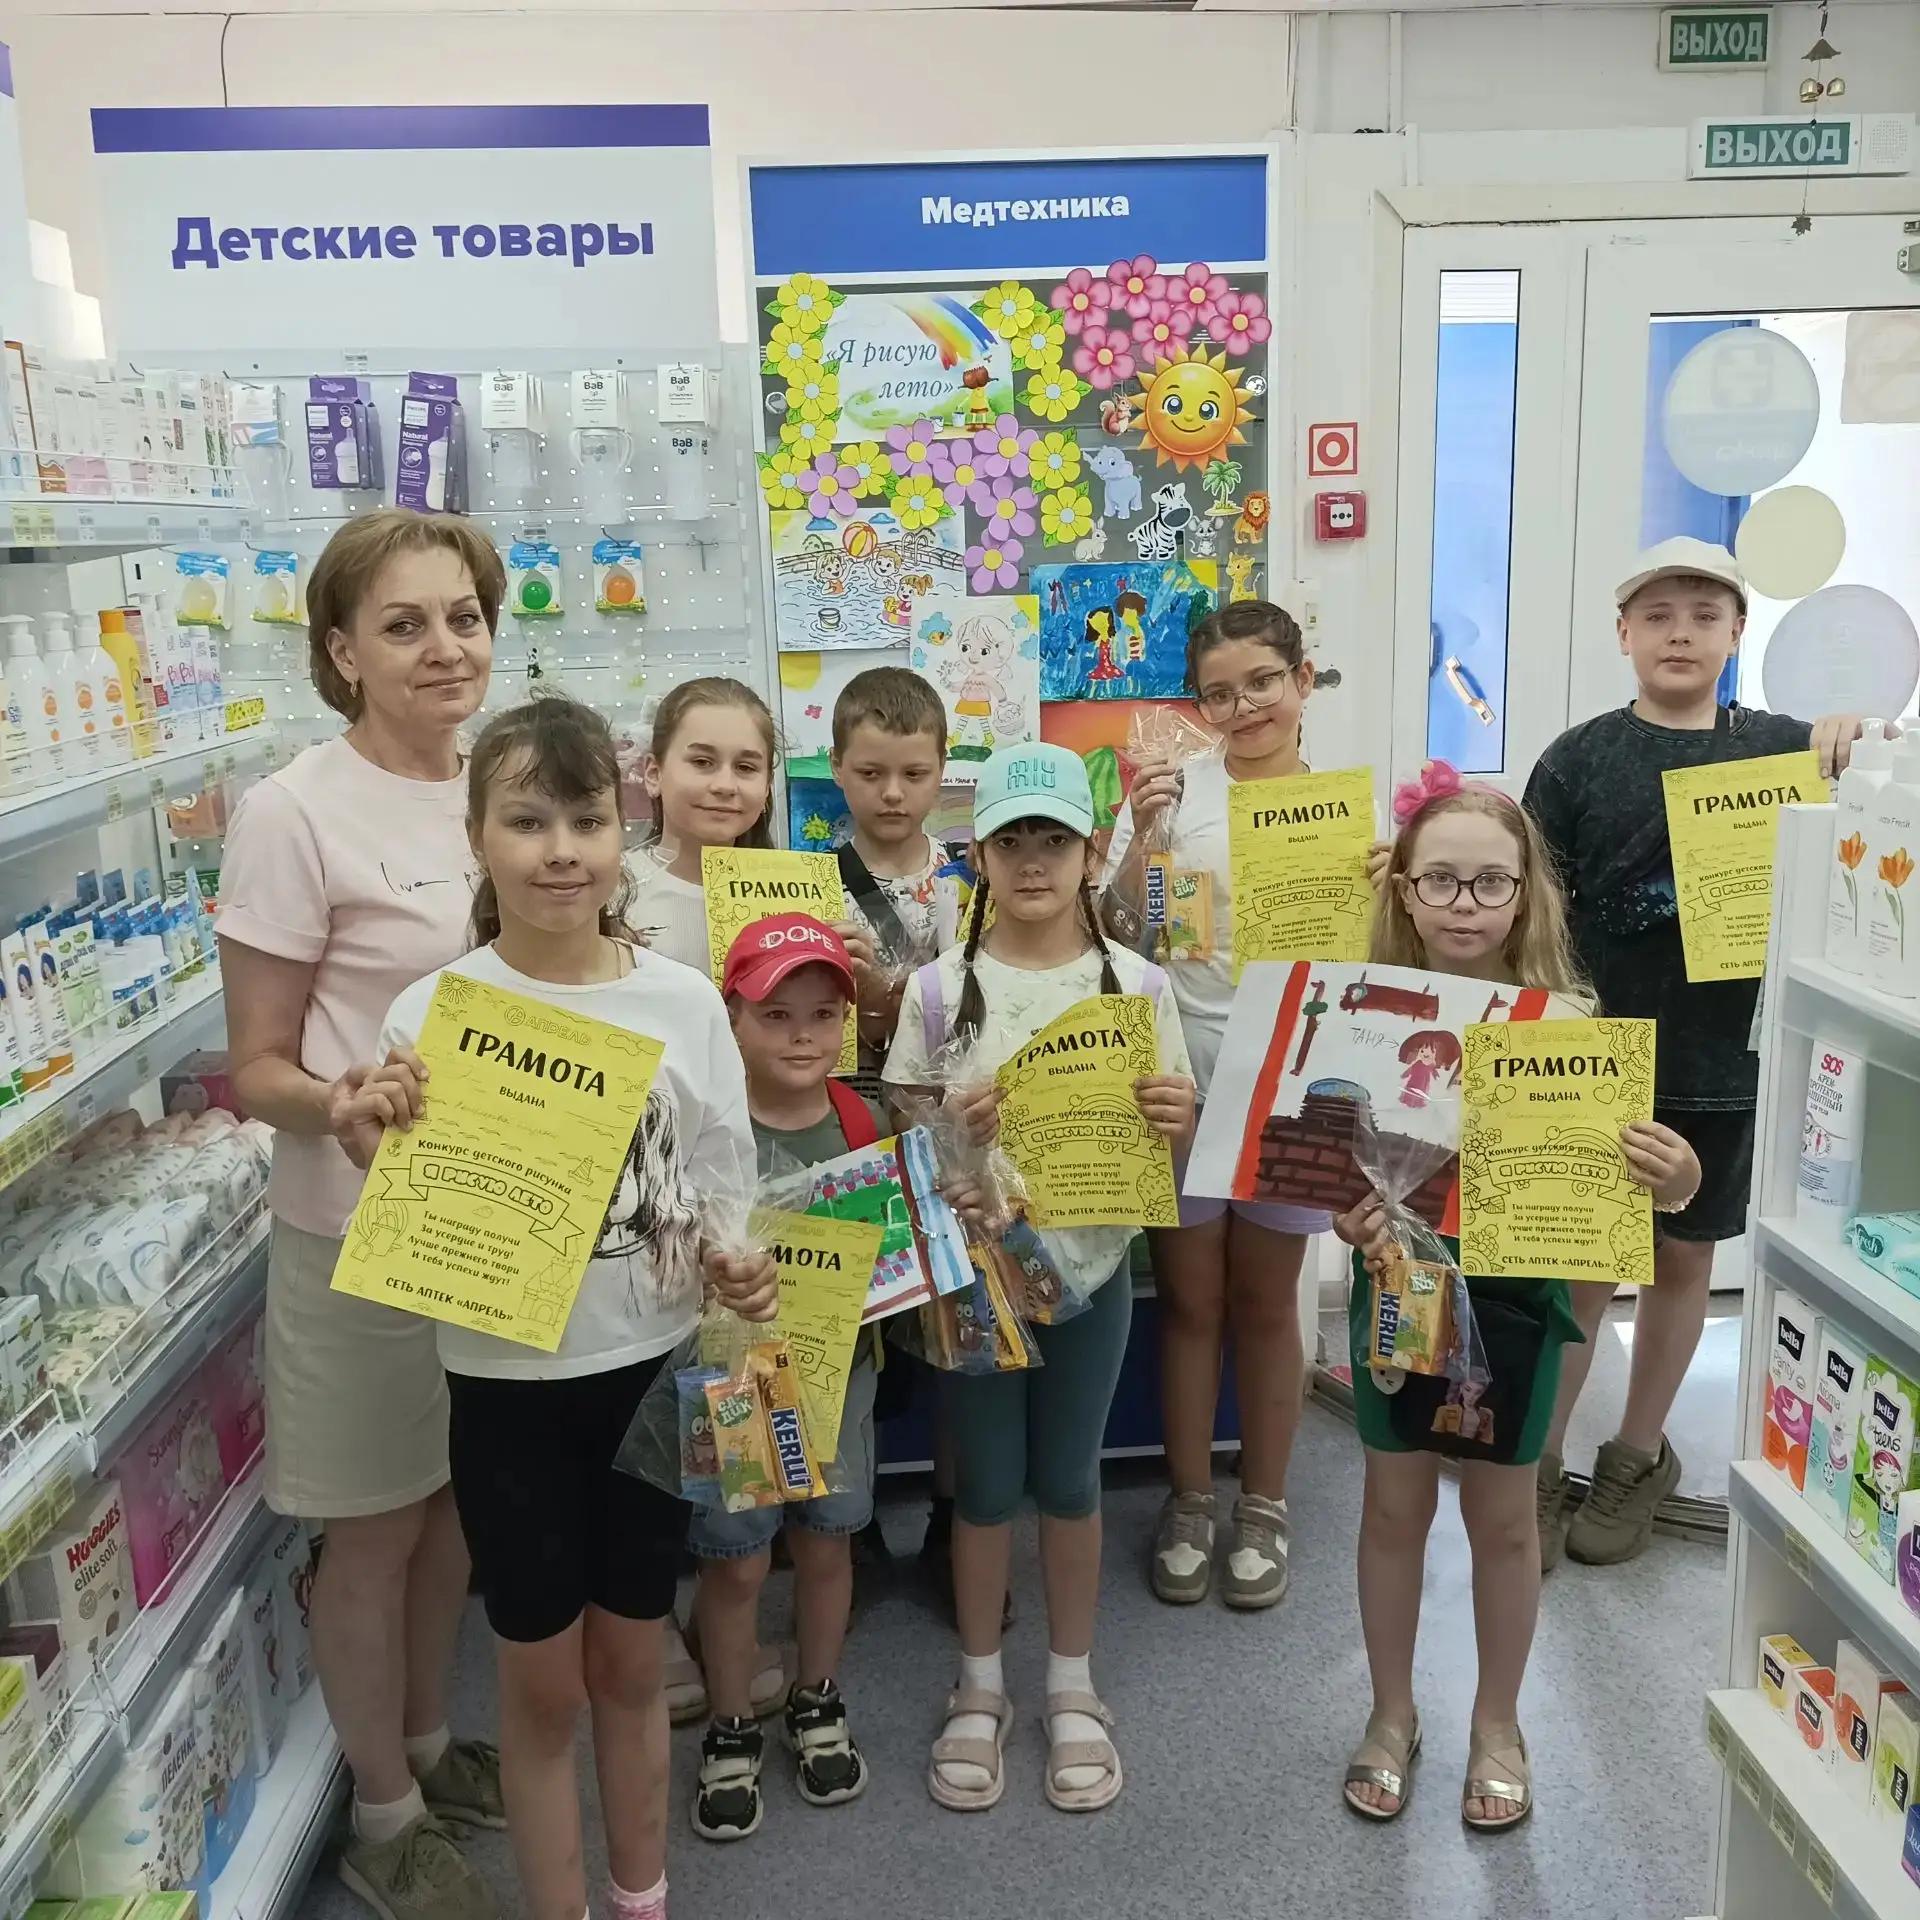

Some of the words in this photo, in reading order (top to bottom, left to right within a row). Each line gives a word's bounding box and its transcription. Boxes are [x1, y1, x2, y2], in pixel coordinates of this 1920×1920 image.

[1673, 14, 1765, 60] ВЫХОД
[1711, 127, 1842, 164] ВЫХОД
[921, 195, 1130, 228] Медтехника
[172, 217, 417, 269] Детские
[433, 222, 655, 268] товары
[827, 339, 856, 363] «Я
[862, 342, 937, 368] рисую
[878, 379, 954, 399] лето»
[1693, 785, 1802, 815] ГРАМОТА
[1253, 801, 1350, 829] ГРАМОТА
[1733, 820, 1768, 830] ВЫДАНА
[1288, 834, 1319, 843] ВЫДАНА
[1698, 869, 1733, 882] Конкурс
[1735, 864, 1773, 874] детского
[729, 880, 823, 900] ГРАМОТА
[1253, 881, 1284, 894] Конкурс
[1287, 877, 1320, 887] детского
[763, 925, 837, 954] DOPE
[1016, 1029, 1127, 1069] ГРАМОТА
[458, 1027, 605, 1098] ГРАМОТА
[1048, 1063, 1097, 1076] ВЫДАНА
[1494, 1056, 1619, 1078] ГРАМОТА
[1821, 1053, 1844, 1076] SOS
[499, 1086, 546, 1109] ВЫДАНА
[1529, 1092, 1581, 1102] ВЫДАНА
[1019, 1113, 1056, 1129] Конкурс
[1095, 1125, 1132, 1139] ЛЕТО
[1488, 1144, 1529, 1157] Конкурс
[418, 1139, 470, 1156] Конкурс
[472, 1149, 523, 1172] детского
[525, 1167, 572, 1195] рисунка
[1513, 1161, 1569, 1176] РИСУЮ
[1571, 1162, 1610, 1180] ЛЕТО
[441, 1166, 508, 1197] РИСУЮ
[507, 1185, 554, 1216] ЛЕТО
[1047, 1209, 1066, 1217] ЕТЬ
[1068, 1207, 1096, 1216] АПТЕК
[1525, 1204, 1561, 1213] награду
[1562, 1206, 1594, 1214] получи
[1525, 1215, 1560, 1224] усердие
[1570, 1216, 1593, 1224] труд!
[424, 1210, 437, 1221] Ты
[439, 1215, 482, 1236] награду
[483, 1229, 521, 1247] получи
[1507, 1224, 1533, 1232] Лучше
[1535, 1226, 1575, 1235] прежнего
[1577, 1227, 1602, 1236] твори
[1543, 1236, 1572, 1245] успехи
[420, 1224, 433, 1234] За
[435, 1229, 476, 1247] усердие
[477, 1242, 485, 1250] и
[487, 1243, 515, 1260] труд!
[407, 1235, 440, 1251] Лучше
[441, 1245, 489, 1266] прежнего
[490, 1260, 520, 1276] твори
[771, 1244, 841, 1272] МОТА
[1501, 1255, 1526, 1265] СЕТЬ
[1528, 1256, 1559, 1266] АПТЕК
[1561, 1257, 1611, 1269] «АПРЕЛЬ»
[411, 1250, 419, 1259] И
[422, 1253, 443, 1267] тебя
[445, 1261, 480, 1278] успехи
[481, 1271, 511, 1287] ждут!
[385, 1276, 414, 1294] СЕТЬ
[416, 1286, 455, 1305] АПТЕК
[456, 1299, 514, 1321] «АПРЕЛЬ»
[787, 1329, 827, 1346] рисунка
[1780, 1324, 1801, 1351] bella
[1829, 1357, 1850, 1384] bella
[1875, 1397, 1895, 1422] bella
[1873, 1427, 1902, 1452] teens
[66, 1502, 121, 1573] HUGGIES
[74, 1561, 102, 1592] elite
[99, 1537, 119, 1568] soft
[1765, 1659, 1782, 1682] bella
[1801, 1700, 1818, 1722] bella
